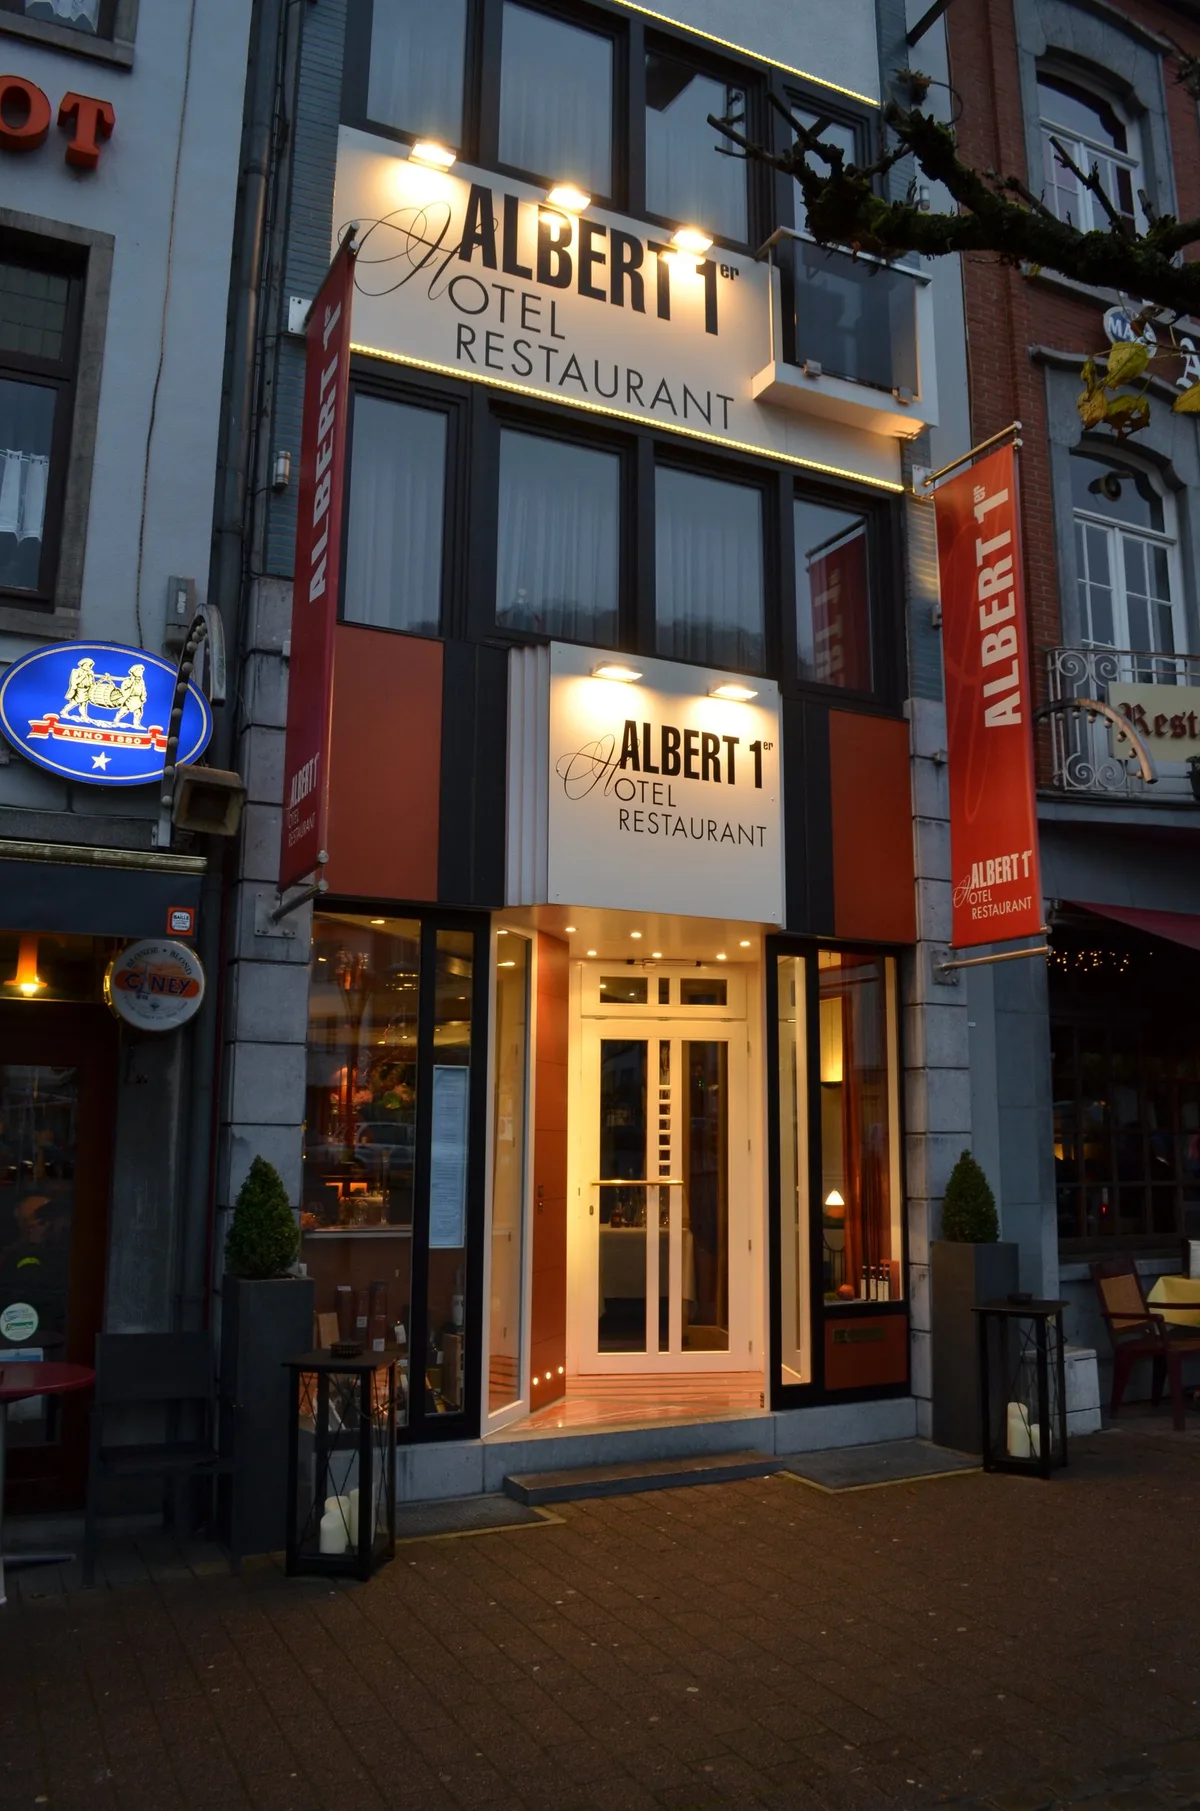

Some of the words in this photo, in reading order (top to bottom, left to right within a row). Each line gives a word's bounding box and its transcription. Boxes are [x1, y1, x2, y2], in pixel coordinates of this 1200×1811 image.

[0, 75, 115, 169] OT
[458, 183, 677, 321] ALBERT
[456, 323, 735, 430] RESTAURANT
[309, 352, 338, 603] ALBERT
[975, 529, 1022, 728] ALBERT
[62, 729, 103, 740] ANNO
[109, 735, 142, 745] 1880
[619, 719, 740, 786] ALBERT
[1117, 702, 1200, 739] Rest
[556, 734, 677, 808] HOTEL
[619, 808, 768, 847] RESTAURANT
[971, 852, 1019, 890] ALBERT
[971, 896, 1032, 920] RESTAURANT
[126, 946, 160, 968] BLONDE
[169, 950, 193, 976] BLOND
